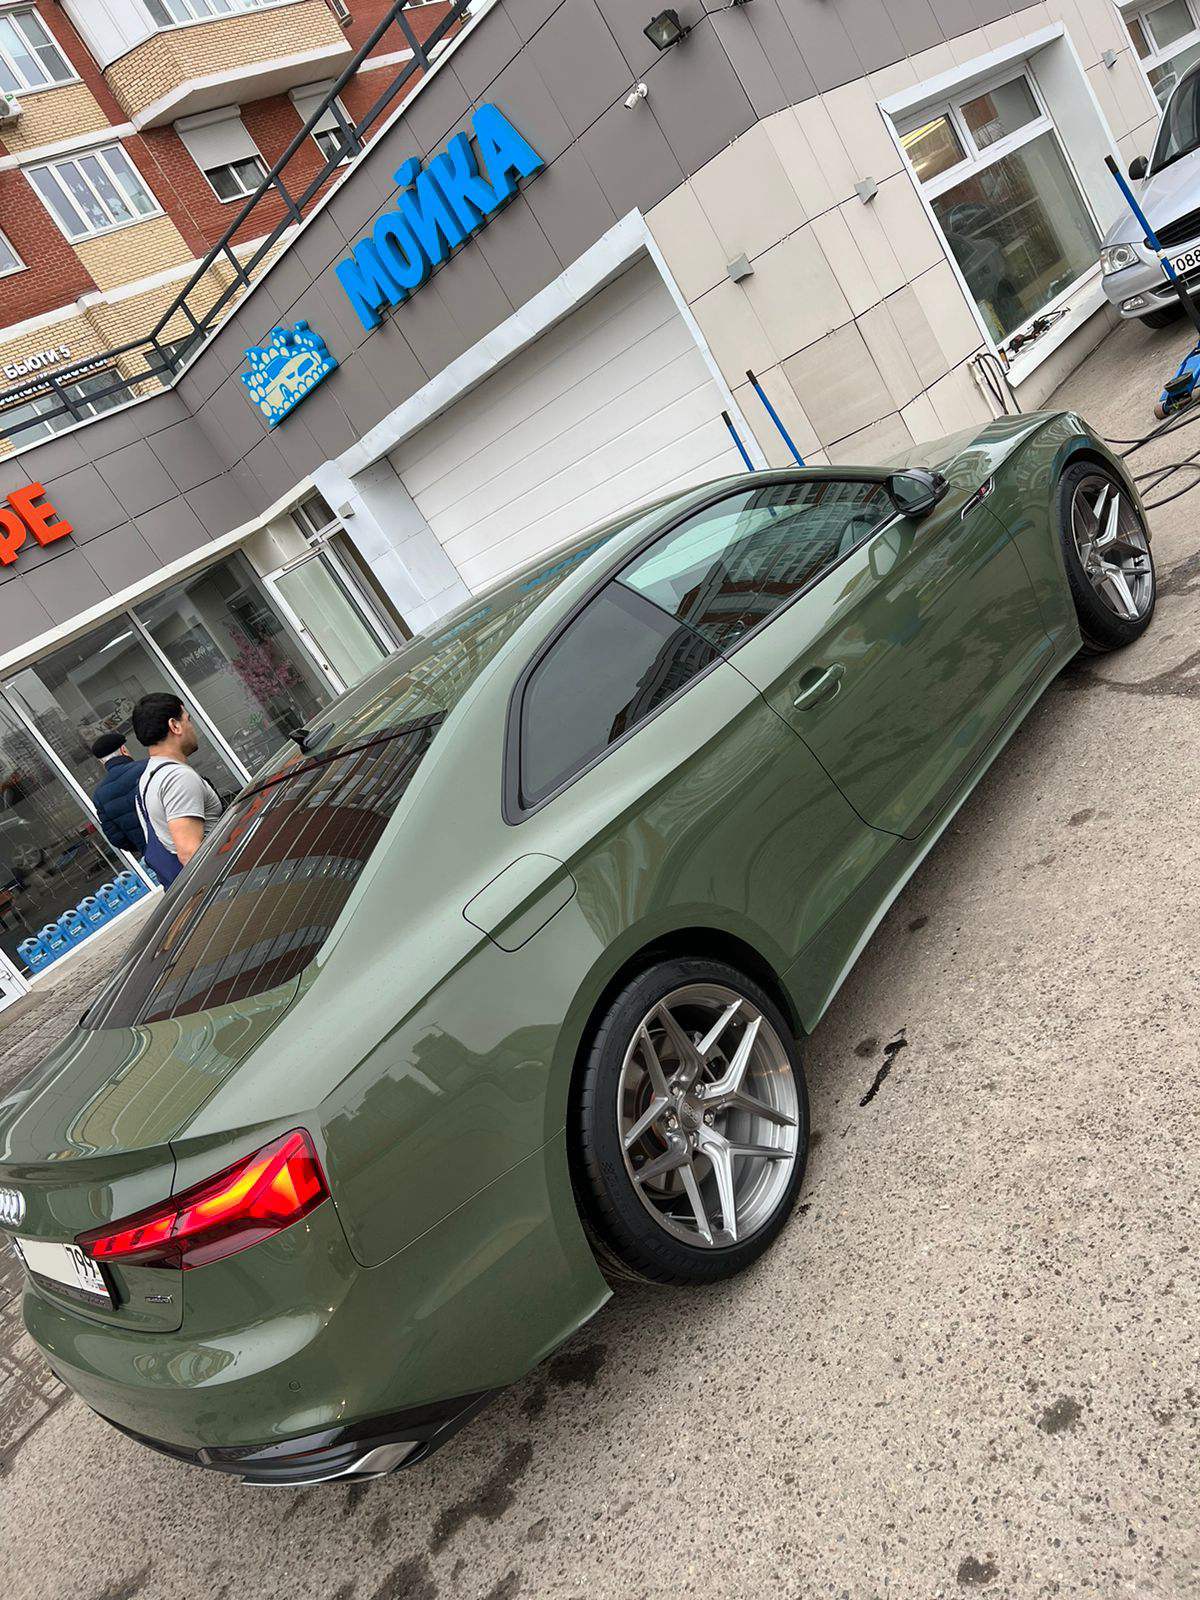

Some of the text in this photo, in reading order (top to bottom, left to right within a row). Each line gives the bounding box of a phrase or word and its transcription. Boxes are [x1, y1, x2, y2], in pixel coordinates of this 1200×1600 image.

[335, 103, 545, 331] МОЙКА
[3, 348, 60, 379] БЬЮТИ
[59, 344, 71, 359] 5
